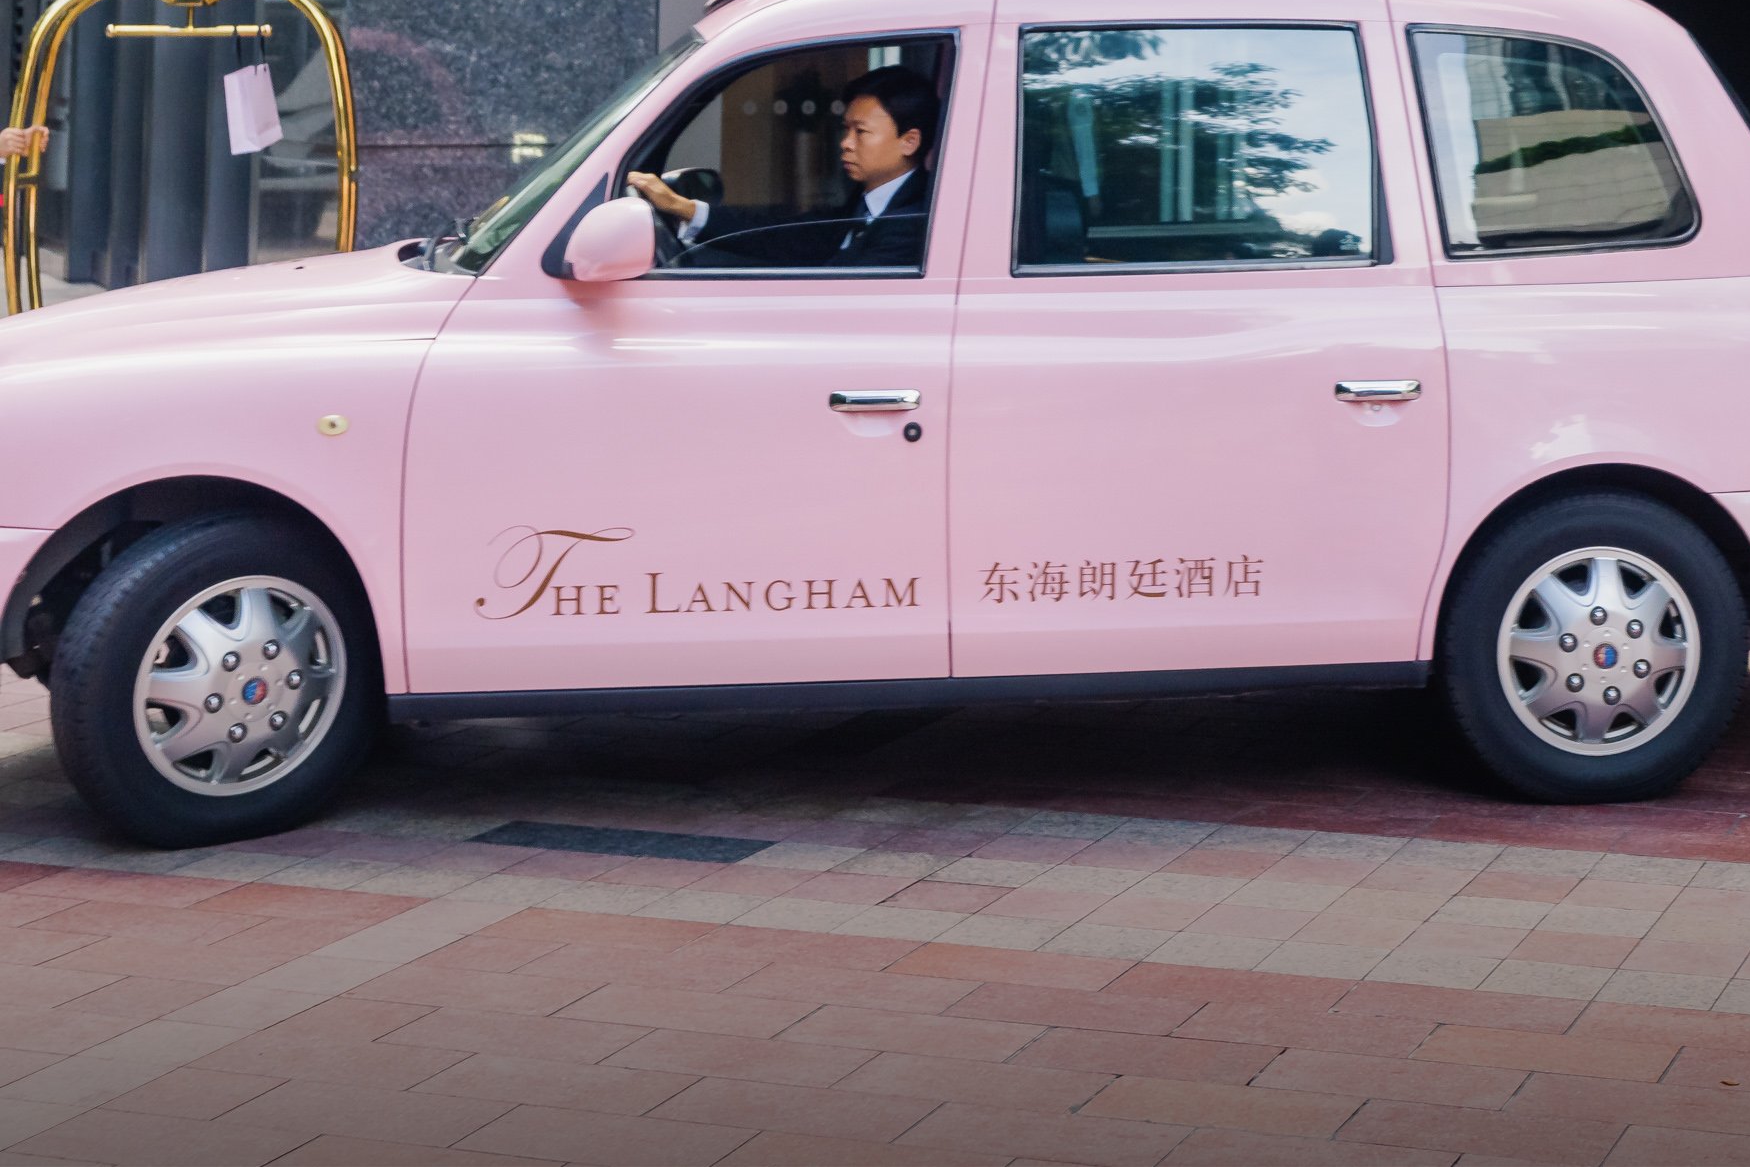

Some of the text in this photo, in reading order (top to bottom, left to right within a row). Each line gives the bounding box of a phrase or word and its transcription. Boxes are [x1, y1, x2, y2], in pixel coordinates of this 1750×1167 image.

[644, 572, 921, 615] LANGHAM
[978, 554, 1266, 604] 东海朗廷酒店
